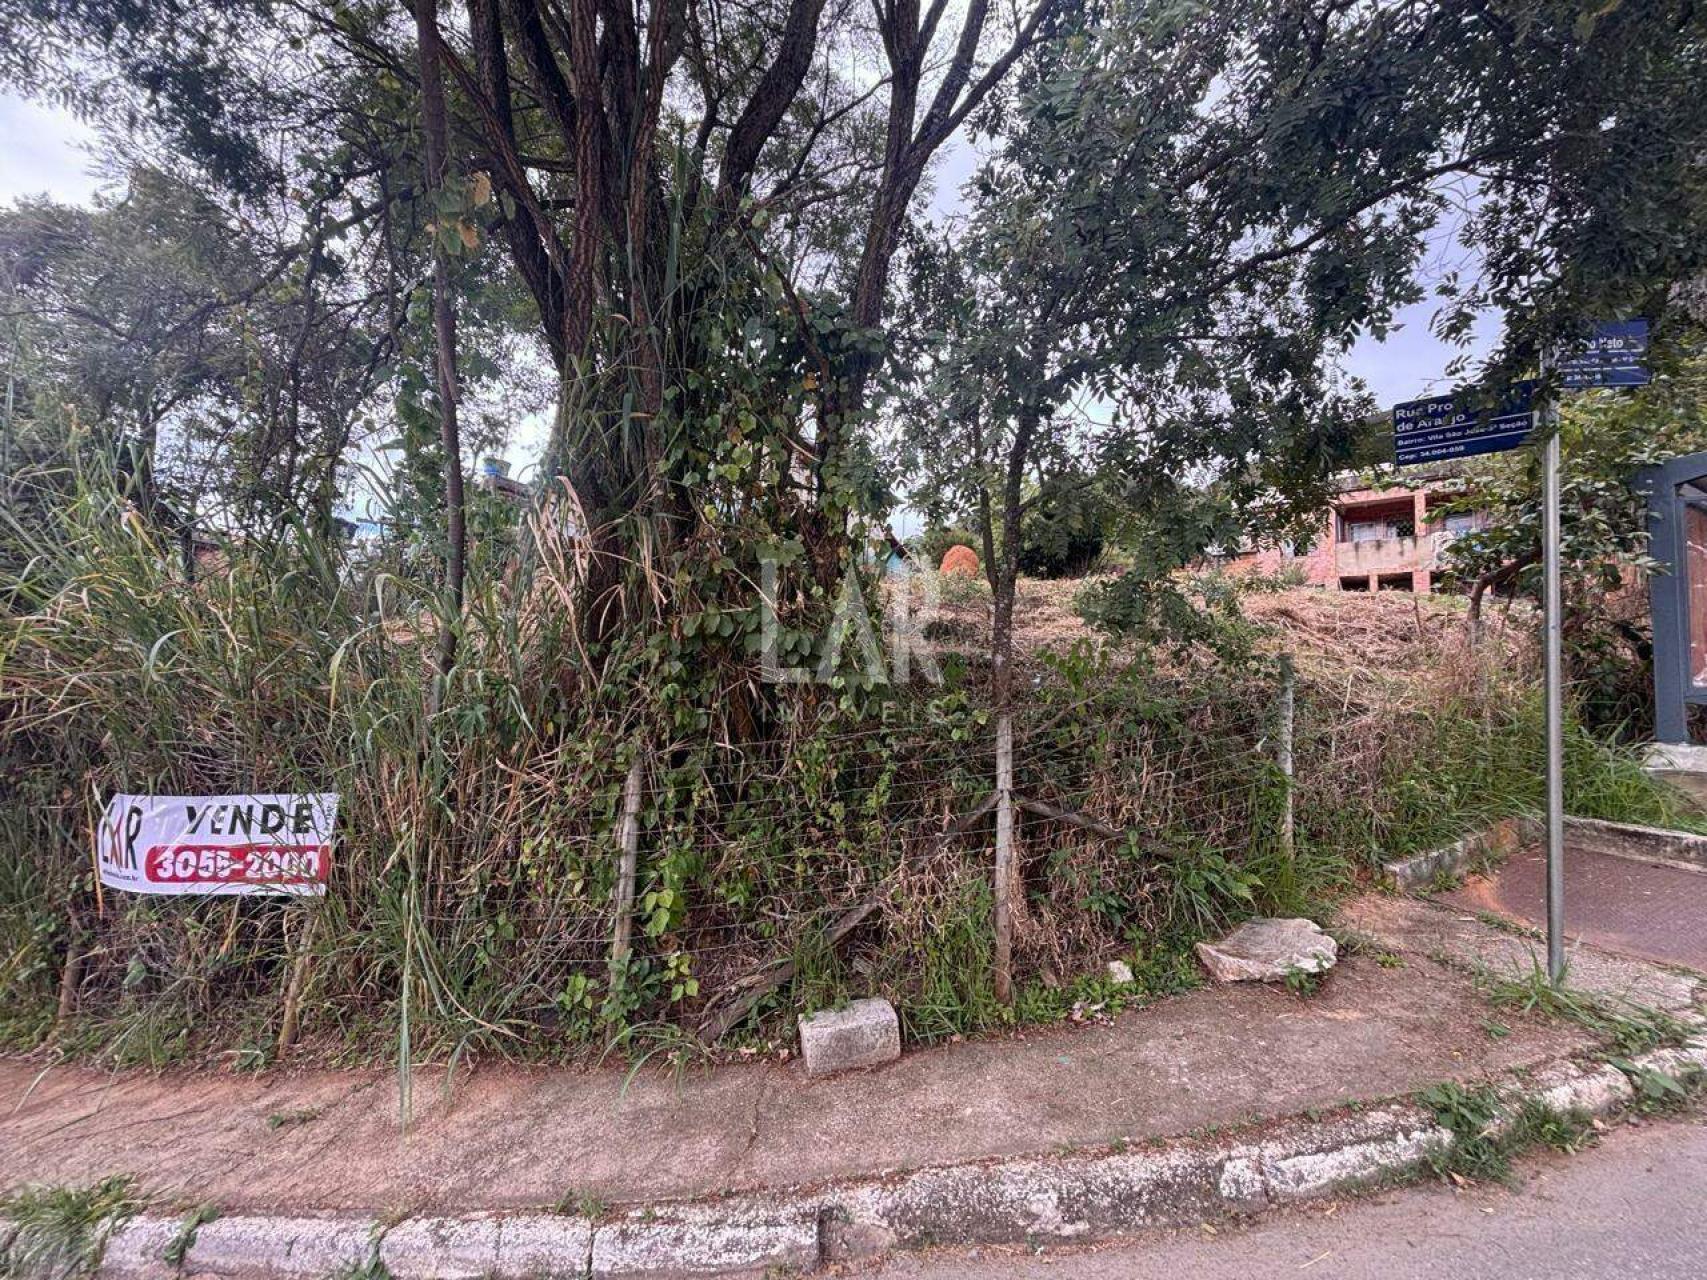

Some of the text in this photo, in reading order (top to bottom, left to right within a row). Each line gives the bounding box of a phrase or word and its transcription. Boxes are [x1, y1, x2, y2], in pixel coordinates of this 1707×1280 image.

[1427, 403, 1453, 413] Pro
[1396, 421, 1414, 432] de
[1499, 421, 1528, 431] Seção
[186, 803, 313, 835] VENDE
